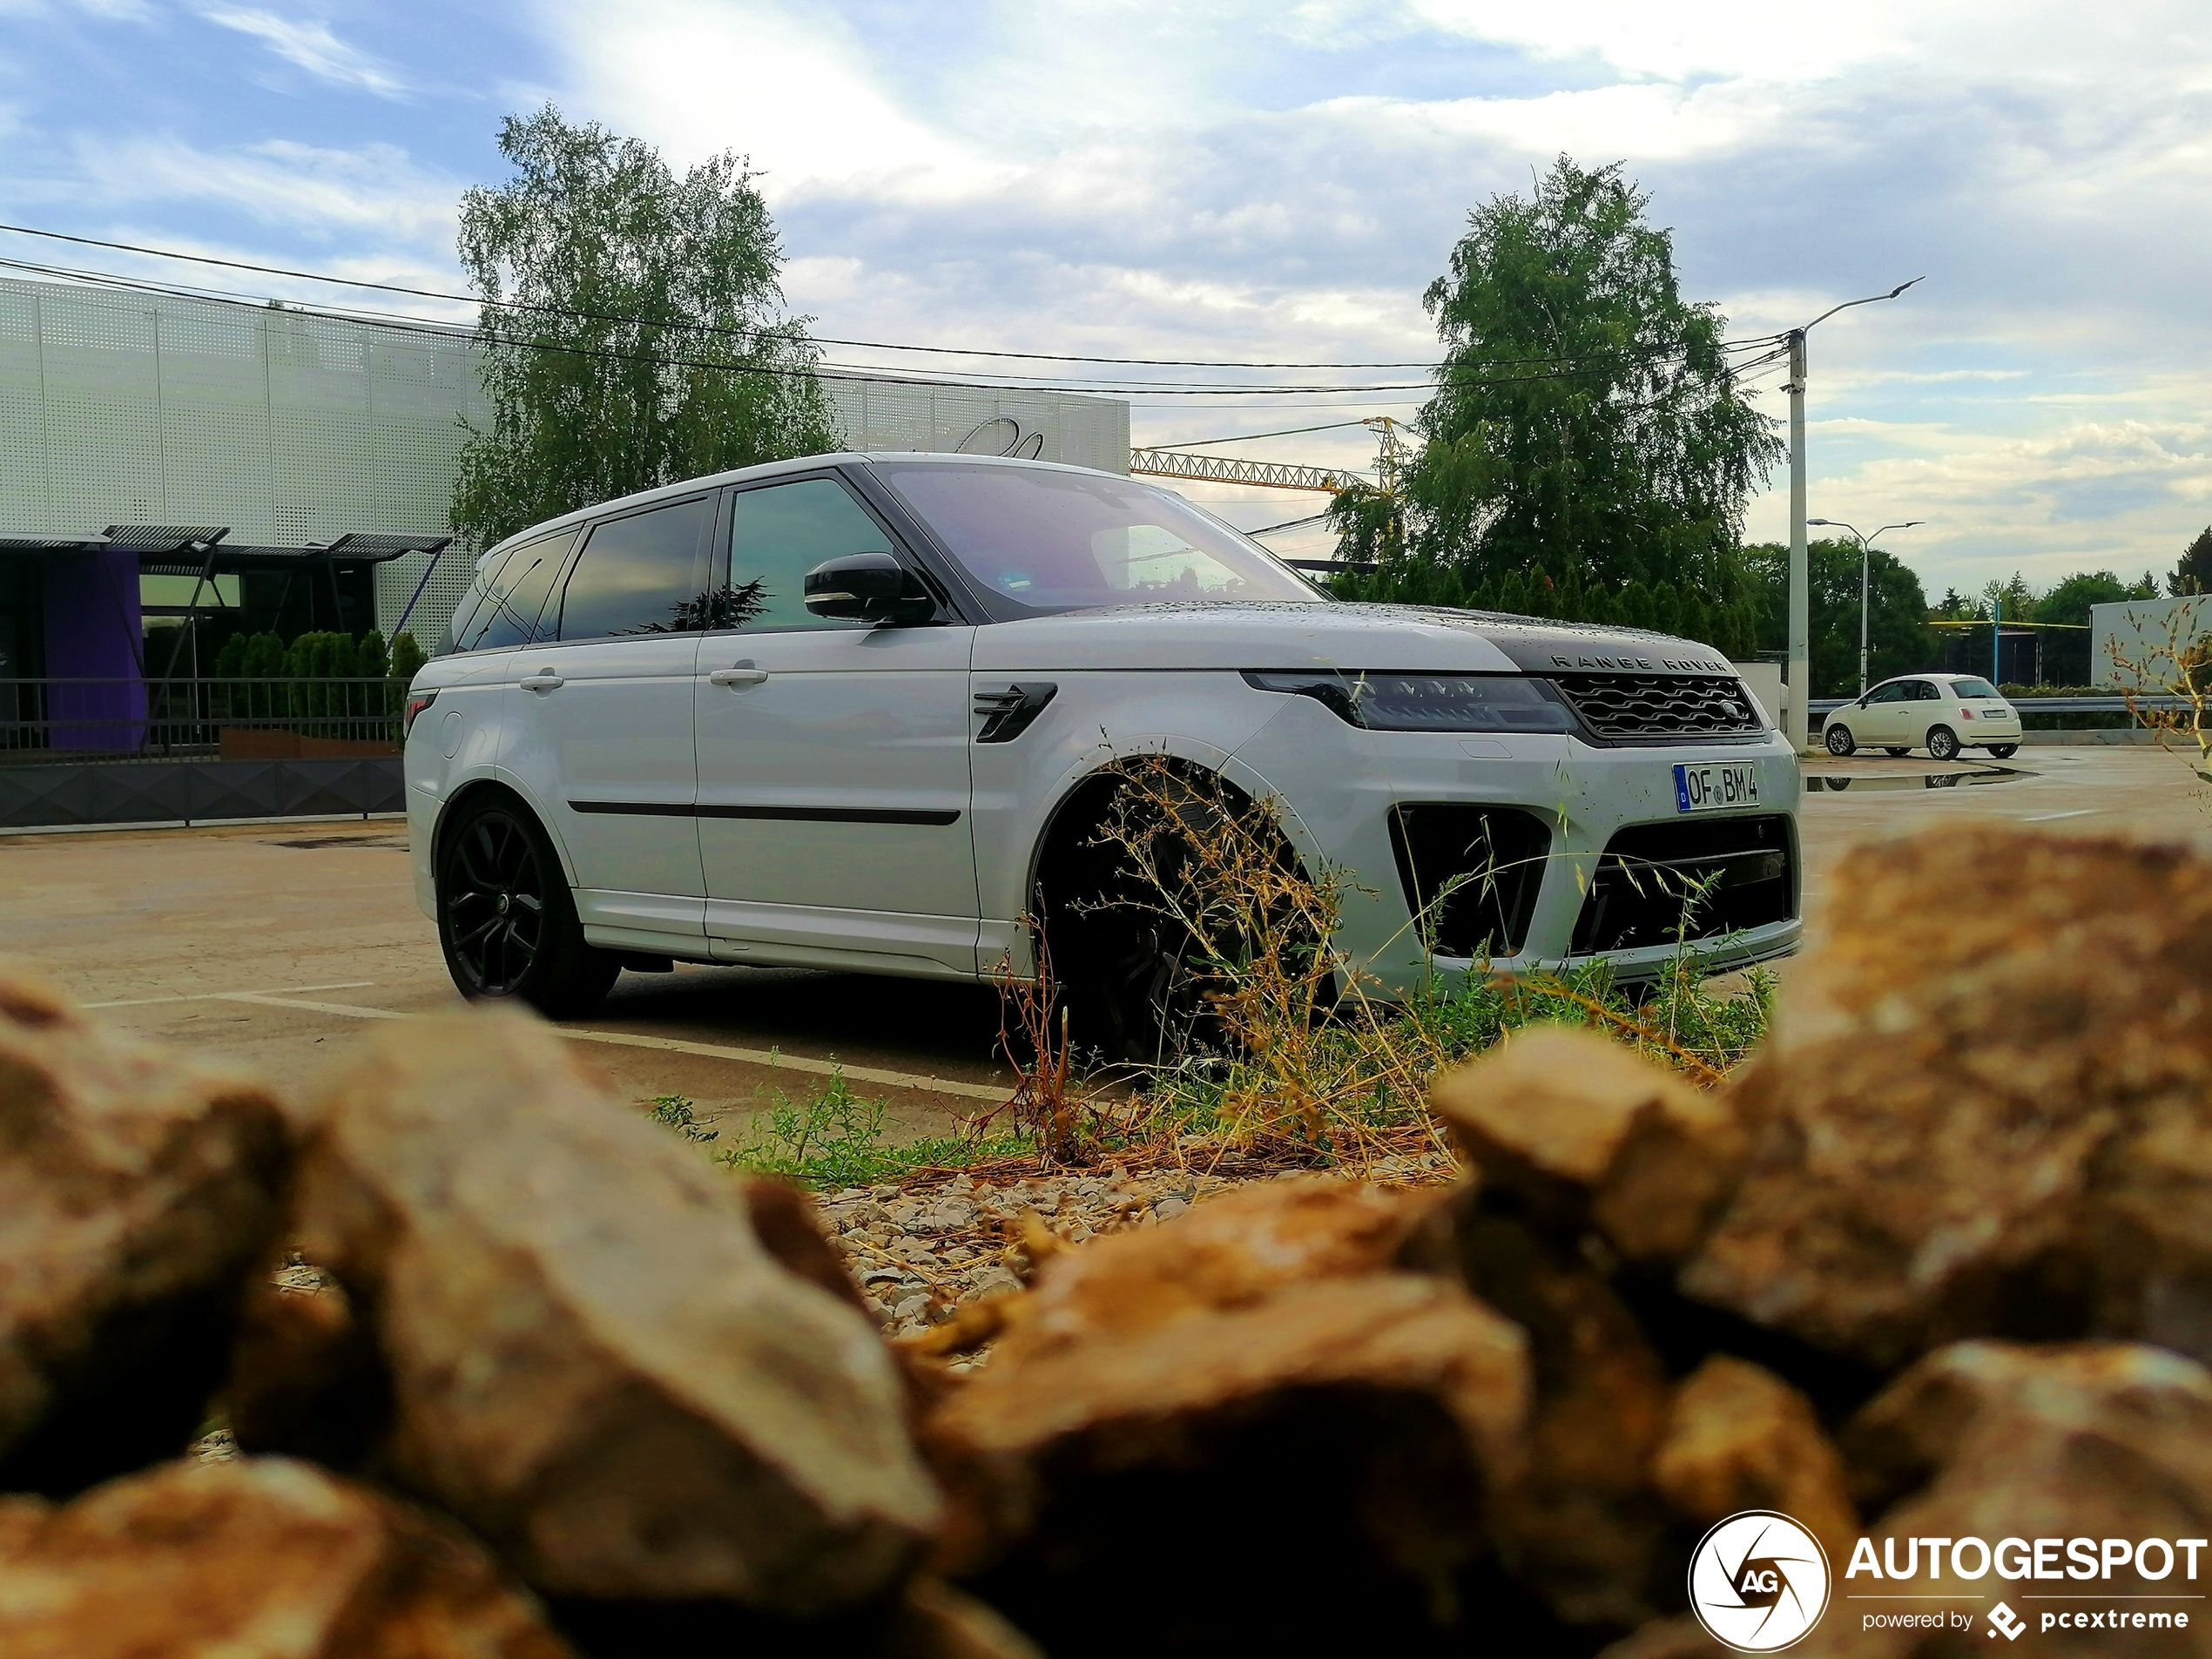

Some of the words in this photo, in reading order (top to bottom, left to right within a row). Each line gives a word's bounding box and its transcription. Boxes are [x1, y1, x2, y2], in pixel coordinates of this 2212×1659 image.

[1550, 655, 1653, 670] RANGE
[1662, 658, 1727, 671] ROVER
[1688, 770, 1711, 804] OF
